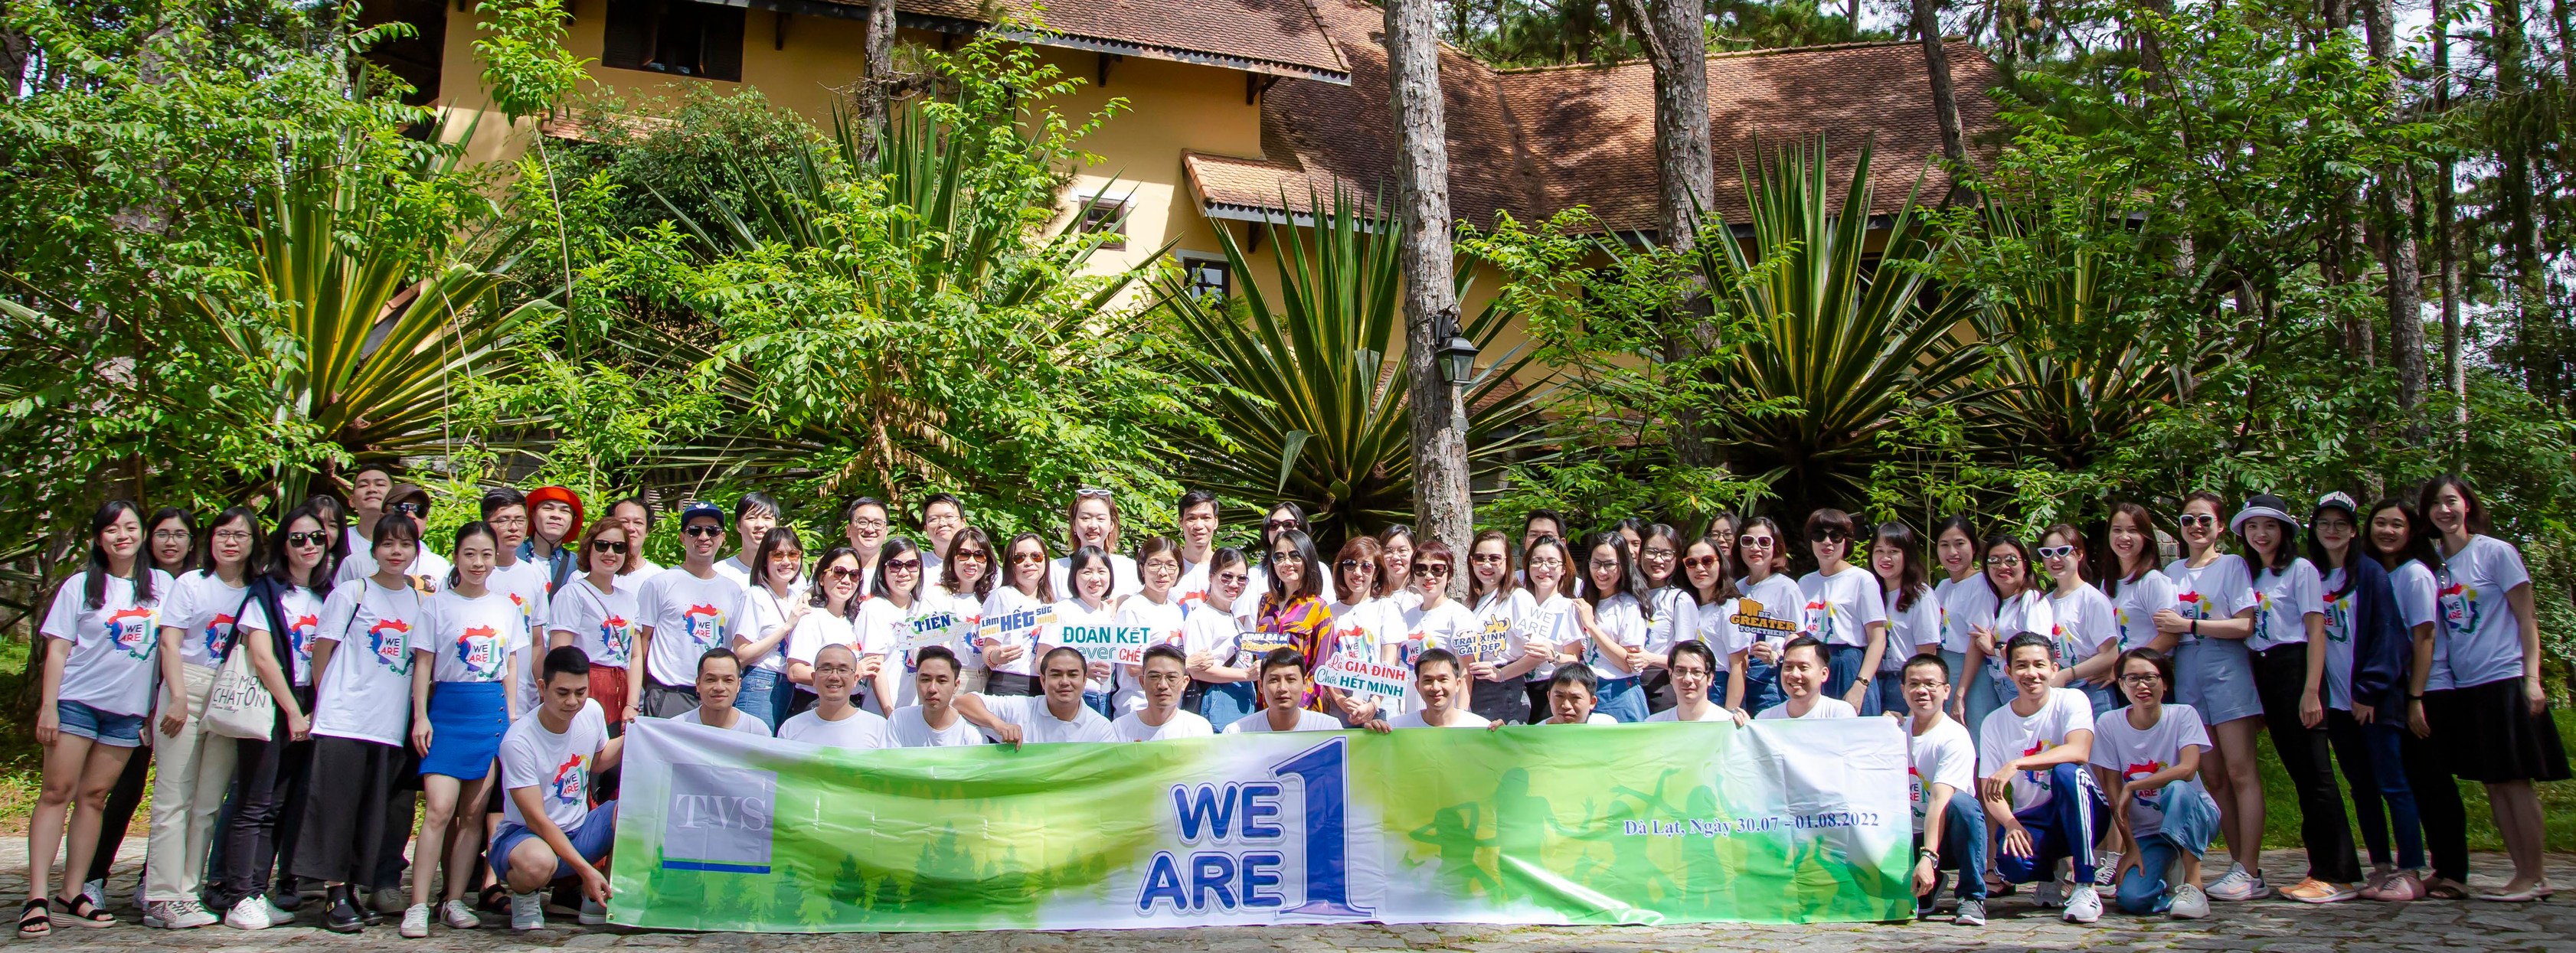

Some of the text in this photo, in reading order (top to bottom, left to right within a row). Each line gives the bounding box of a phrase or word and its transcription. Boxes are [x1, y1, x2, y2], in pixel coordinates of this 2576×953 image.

[2446, 601, 2461, 610] WE
[1000, 605, 1035, 632] HẾT
[1531, 607, 1551, 625] WE
[2448, 609, 2463, 619] ARE
[126, 624, 143, 633] WE
[697, 621, 711, 629] WE
[1518, 619, 1547, 638] ARE
[1730, 615, 1796, 632] GREATER
[119, 633, 142, 642] ARE
[695, 629, 711, 638] ARE
[1739, 625, 1786, 638] TOGETHER
[384, 638, 401, 647] WE
[472, 644, 489, 653] WE
[1345, 642, 1359, 651] WE
[379, 648, 400, 656] ARE
[1409, 646, 1419, 654] WE
[468, 653, 489, 662] ARE
[1345, 661, 1368, 674] GIA
[1371, 664, 1406, 681] ĐÌNH
[1340, 674, 1365, 689] HẾT
[1368, 679, 1404, 697] MÌNH
[213, 687, 266, 708] CHATON
[564, 773, 578, 785] WE
[562, 782, 580, 795] ARE
[675, 793, 768, 831] TVS
[1169, 781, 1285, 845] WE
[1268, 736, 1377, 919] 1
[1624, 821, 1647, 835] Đà
[1652, 820, 1685, 837] Lạt,
[1690, 818, 1732, 837] Ngày
[1737, 817, 1779, 832] 30.07
[1796, 812, 1879, 829] 01.08.2022
[1135, 850, 1287, 915] ARE
